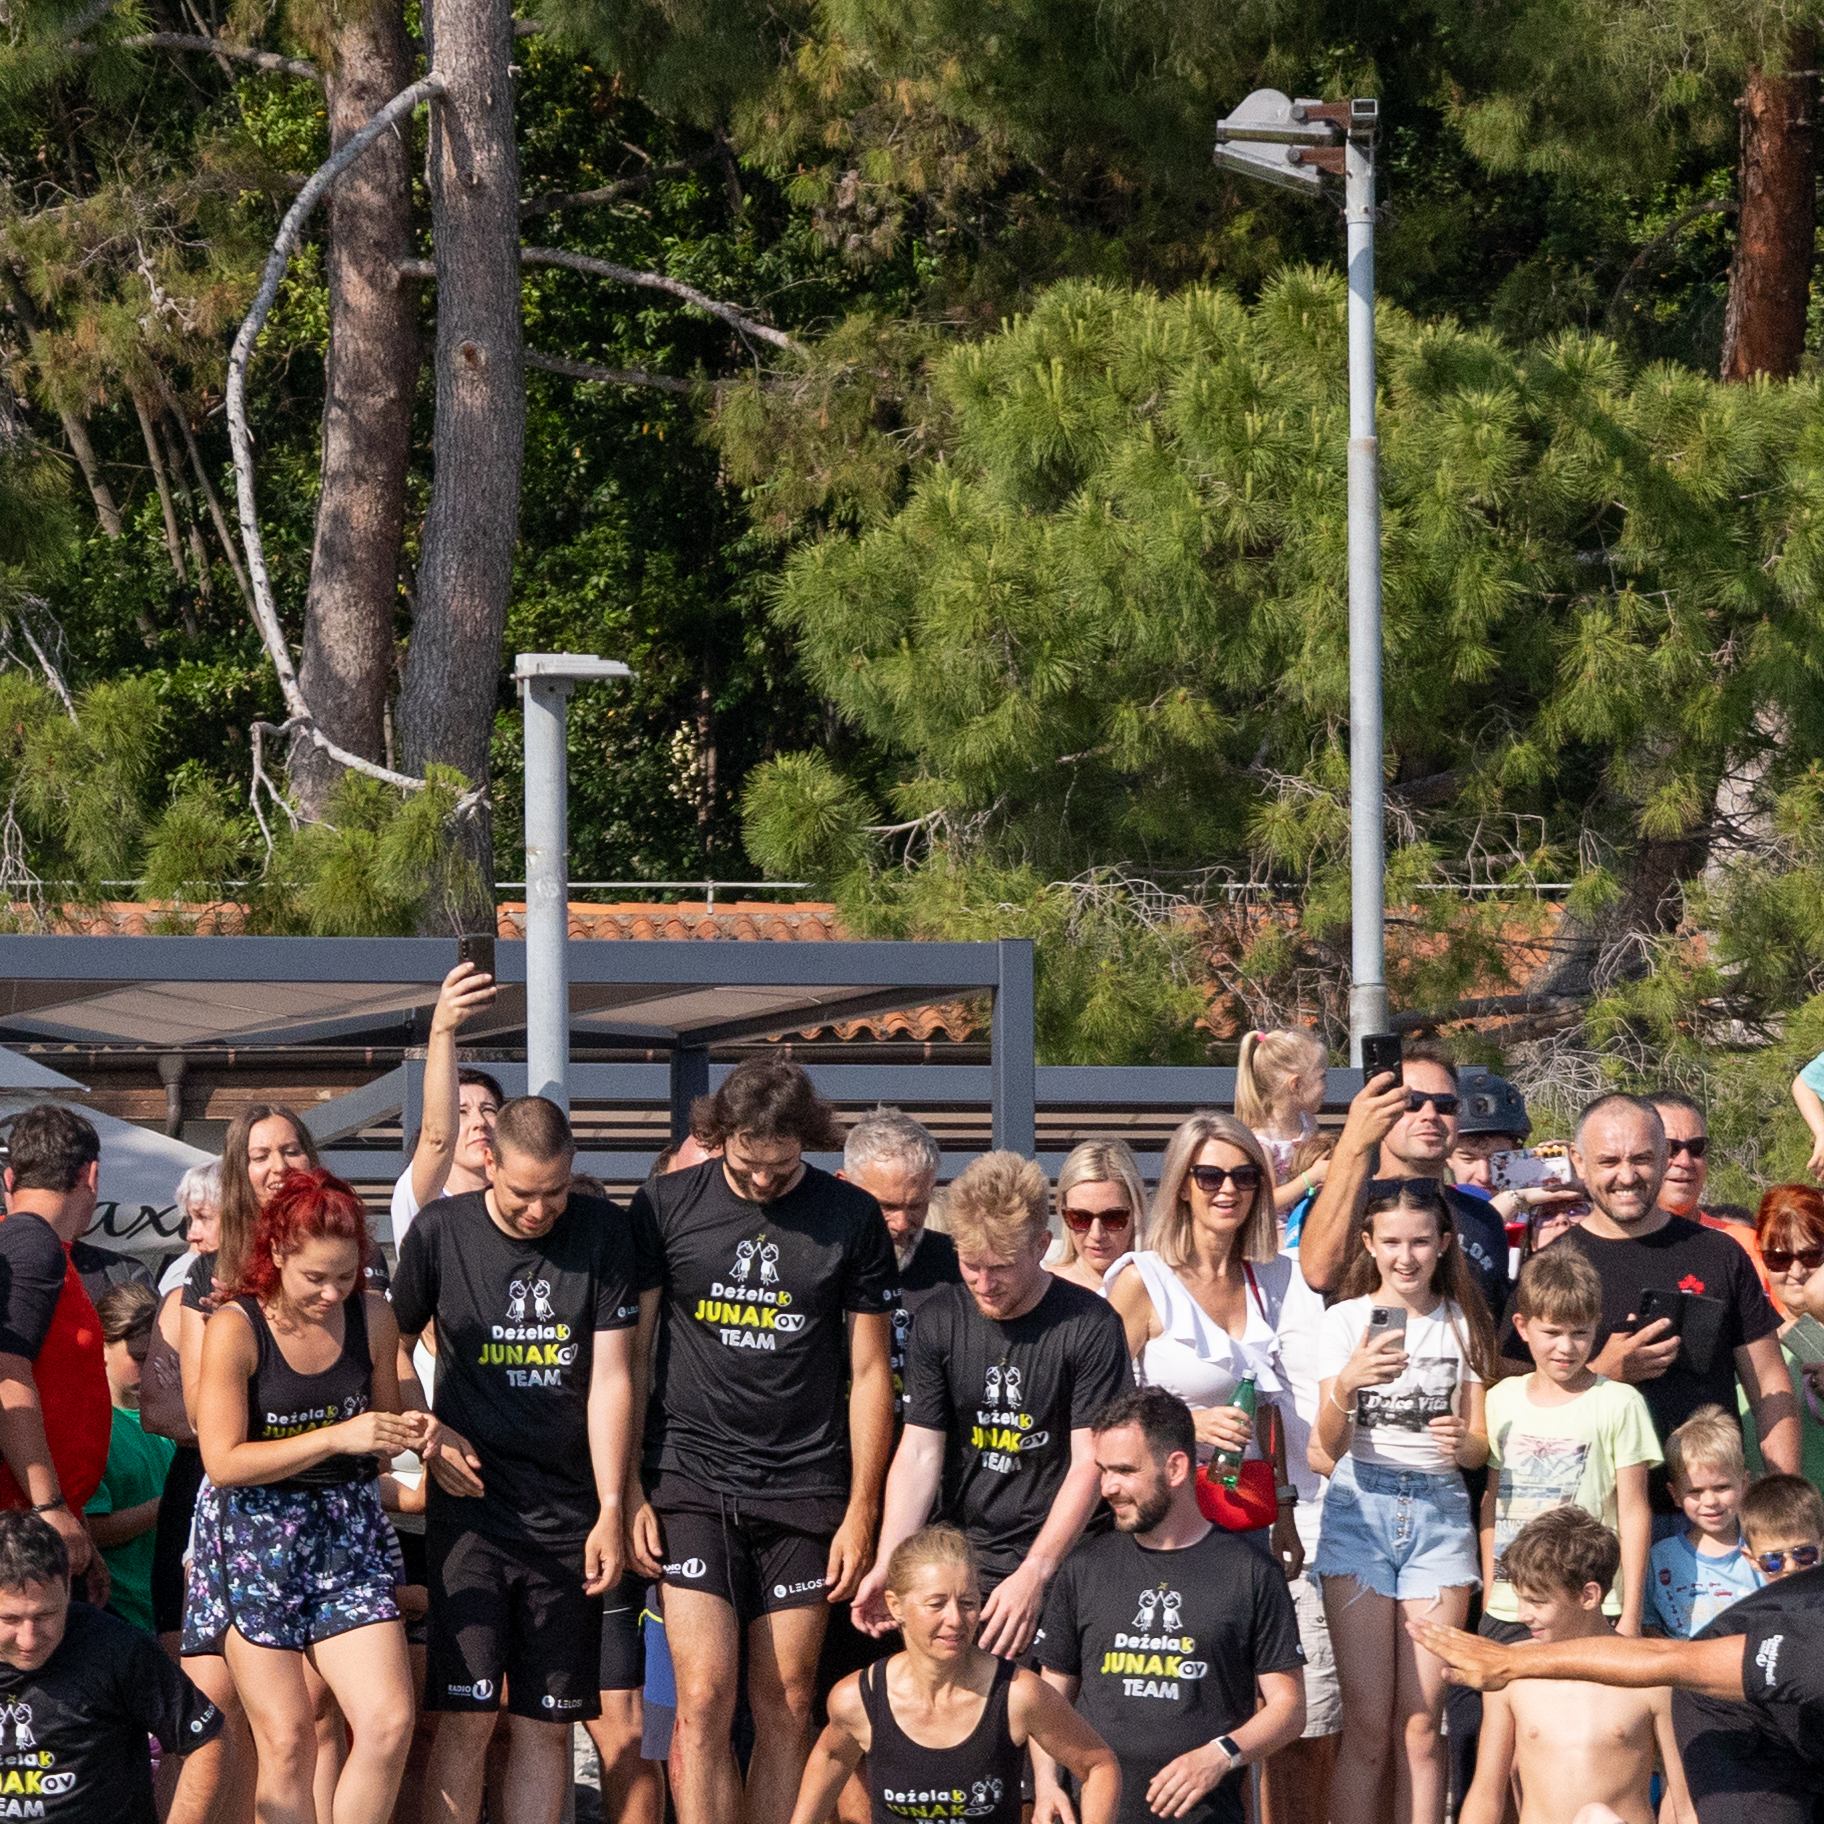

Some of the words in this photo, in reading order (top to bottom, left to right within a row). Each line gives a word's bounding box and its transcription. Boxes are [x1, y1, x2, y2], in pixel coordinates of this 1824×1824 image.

[719, 1328, 776, 1351] TEAM
[506, 1369, 562, 1387] TEAM
[1367, 1395, 1413, 1410] Dolce
[1417, 1396, 1448, 1411] Vita
[1122, 1679, 1180, 1701] TEAM
